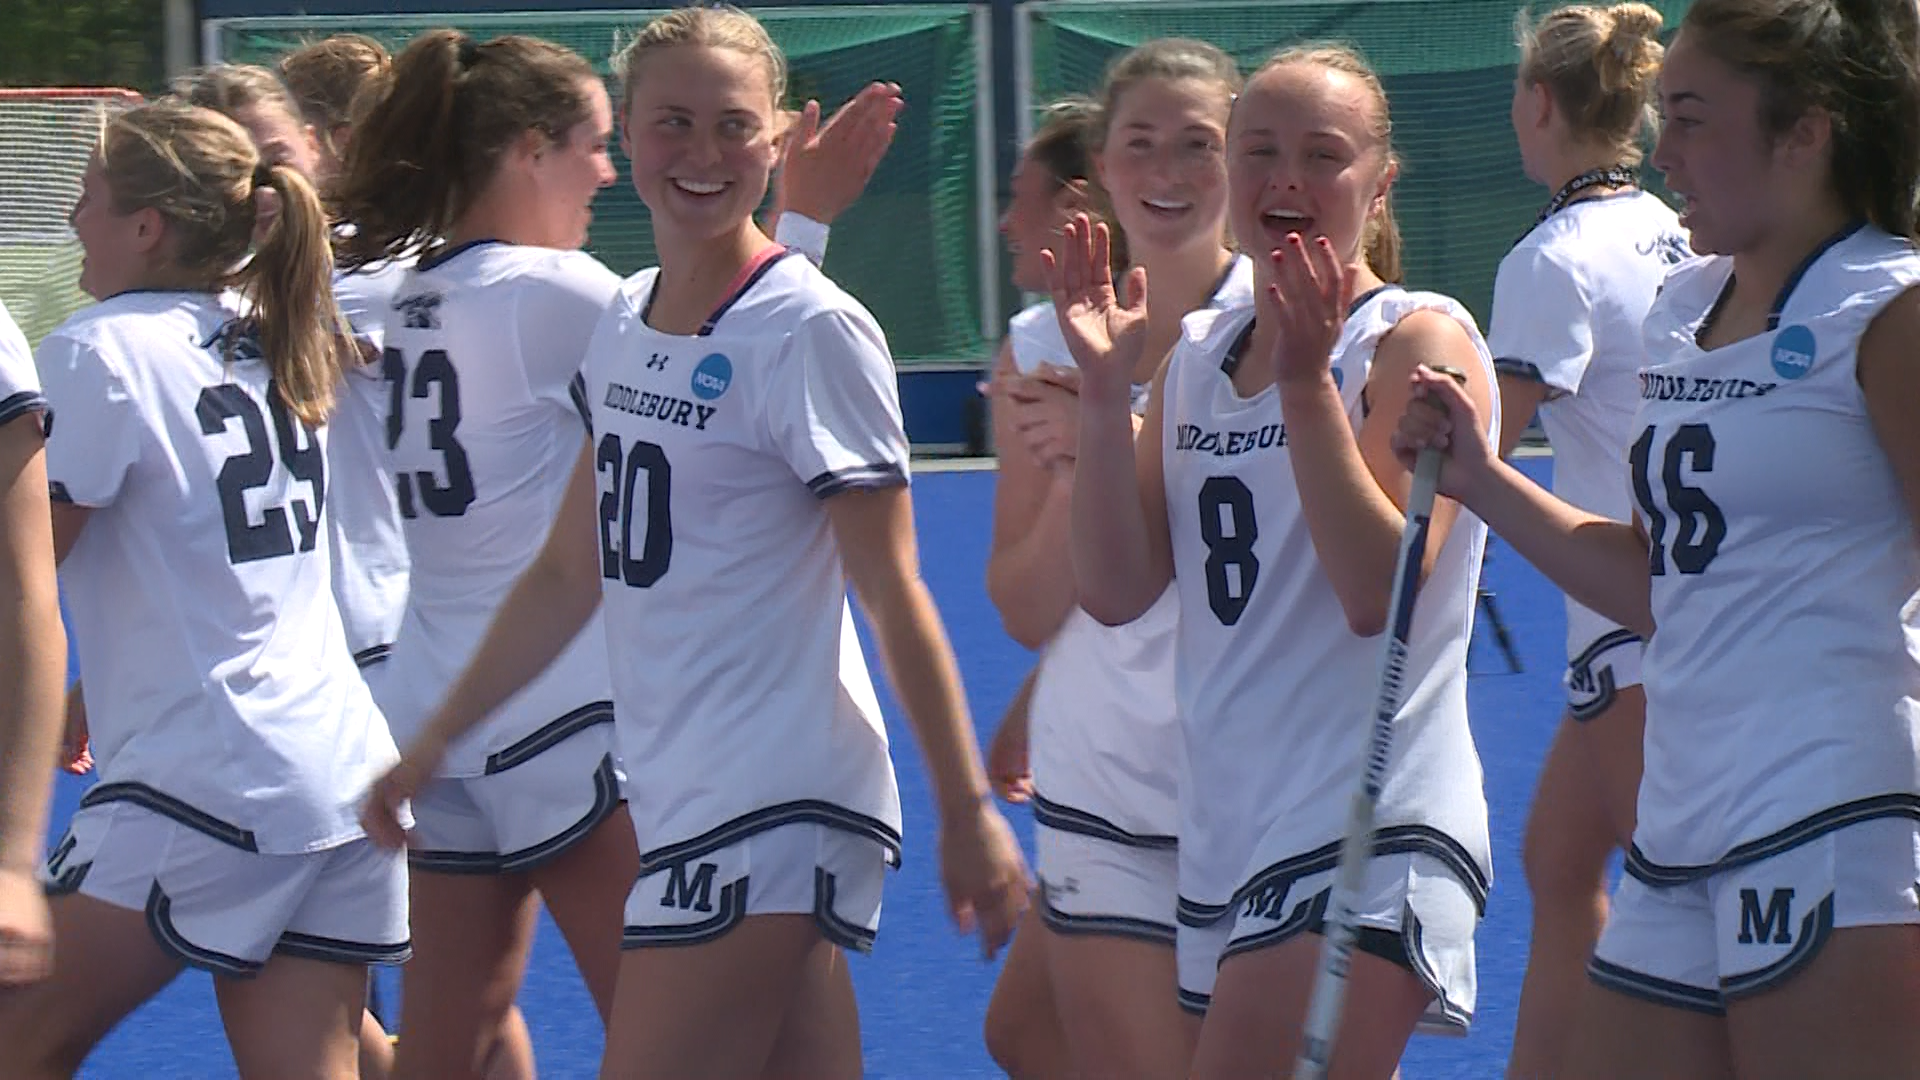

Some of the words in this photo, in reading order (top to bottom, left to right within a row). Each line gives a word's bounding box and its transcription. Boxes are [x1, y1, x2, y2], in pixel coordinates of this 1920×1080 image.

[597, 432, 673, 589] 20
[1198, 475, 1260, 626] 8
[1629, 423, 1728, 576] 16
[660, 860, 718, 912] M
[1737, 887, 1795, 944] M
